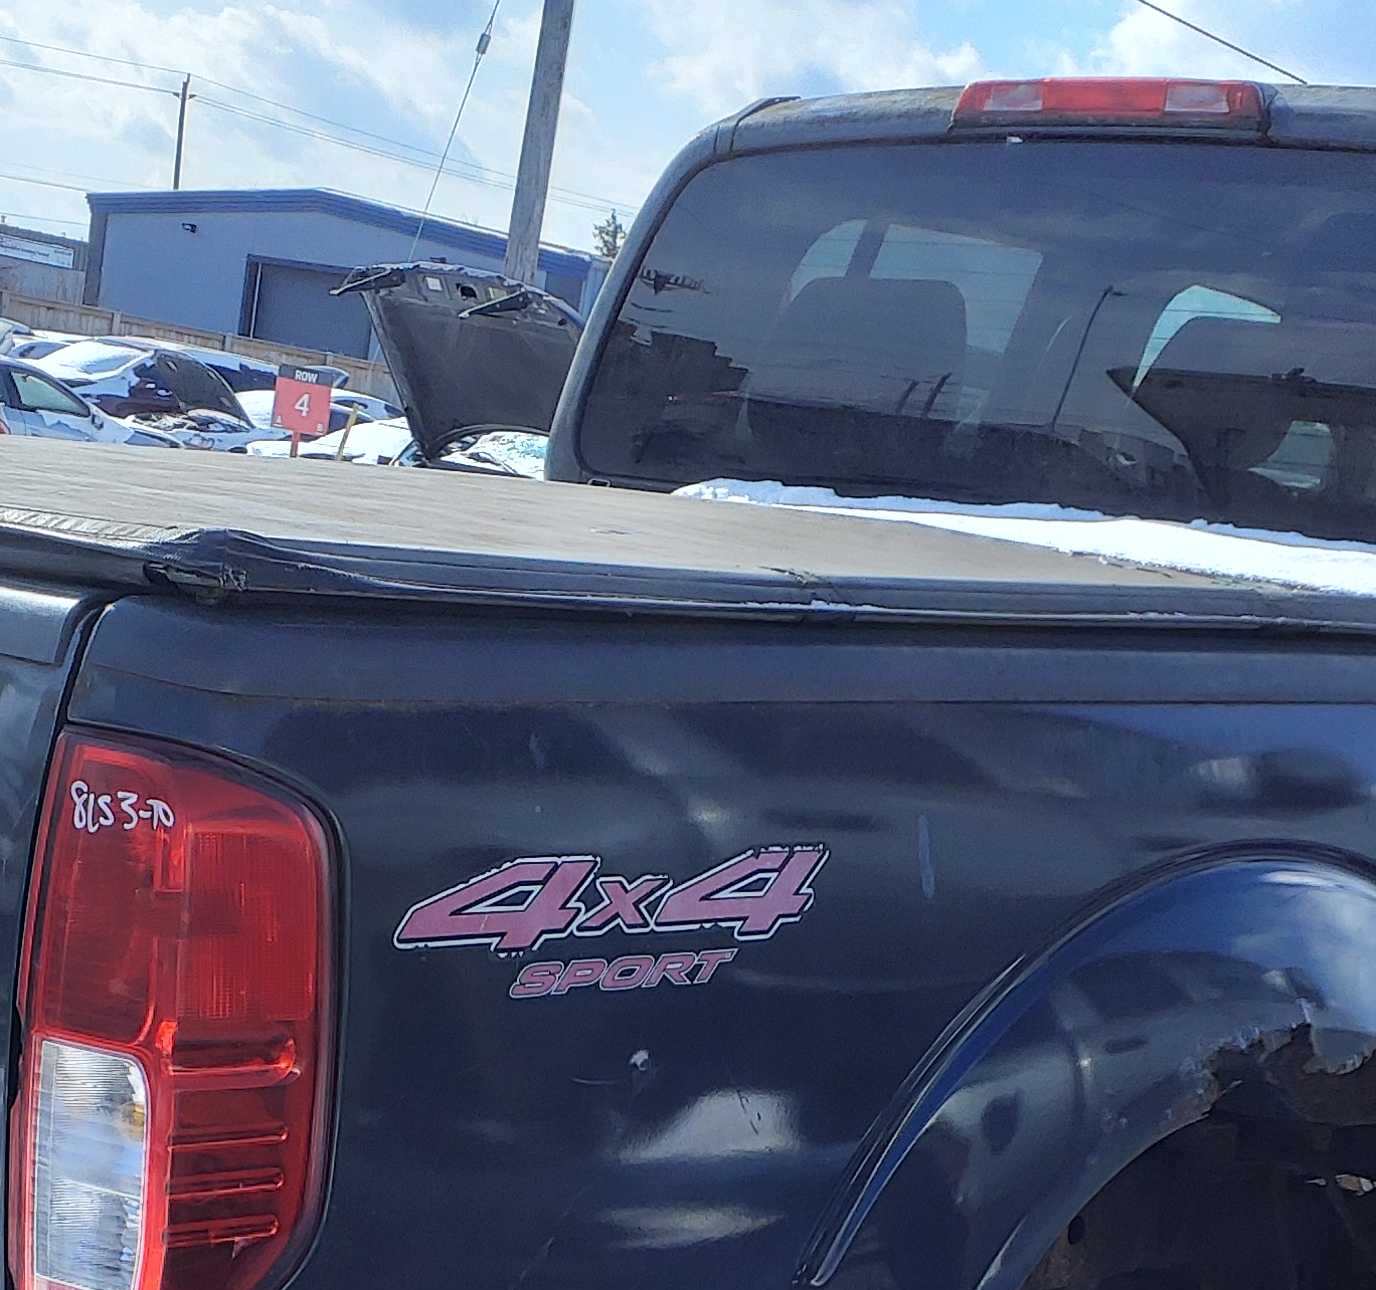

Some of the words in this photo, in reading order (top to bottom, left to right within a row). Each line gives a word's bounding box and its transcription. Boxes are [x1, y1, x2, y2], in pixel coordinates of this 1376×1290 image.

[295, 370, 319, 384] ROW
[294, 393, 310, 417] 4
[393, 843, 828, 959] 4x4
[509, 946, 739, 1000] SPORT
